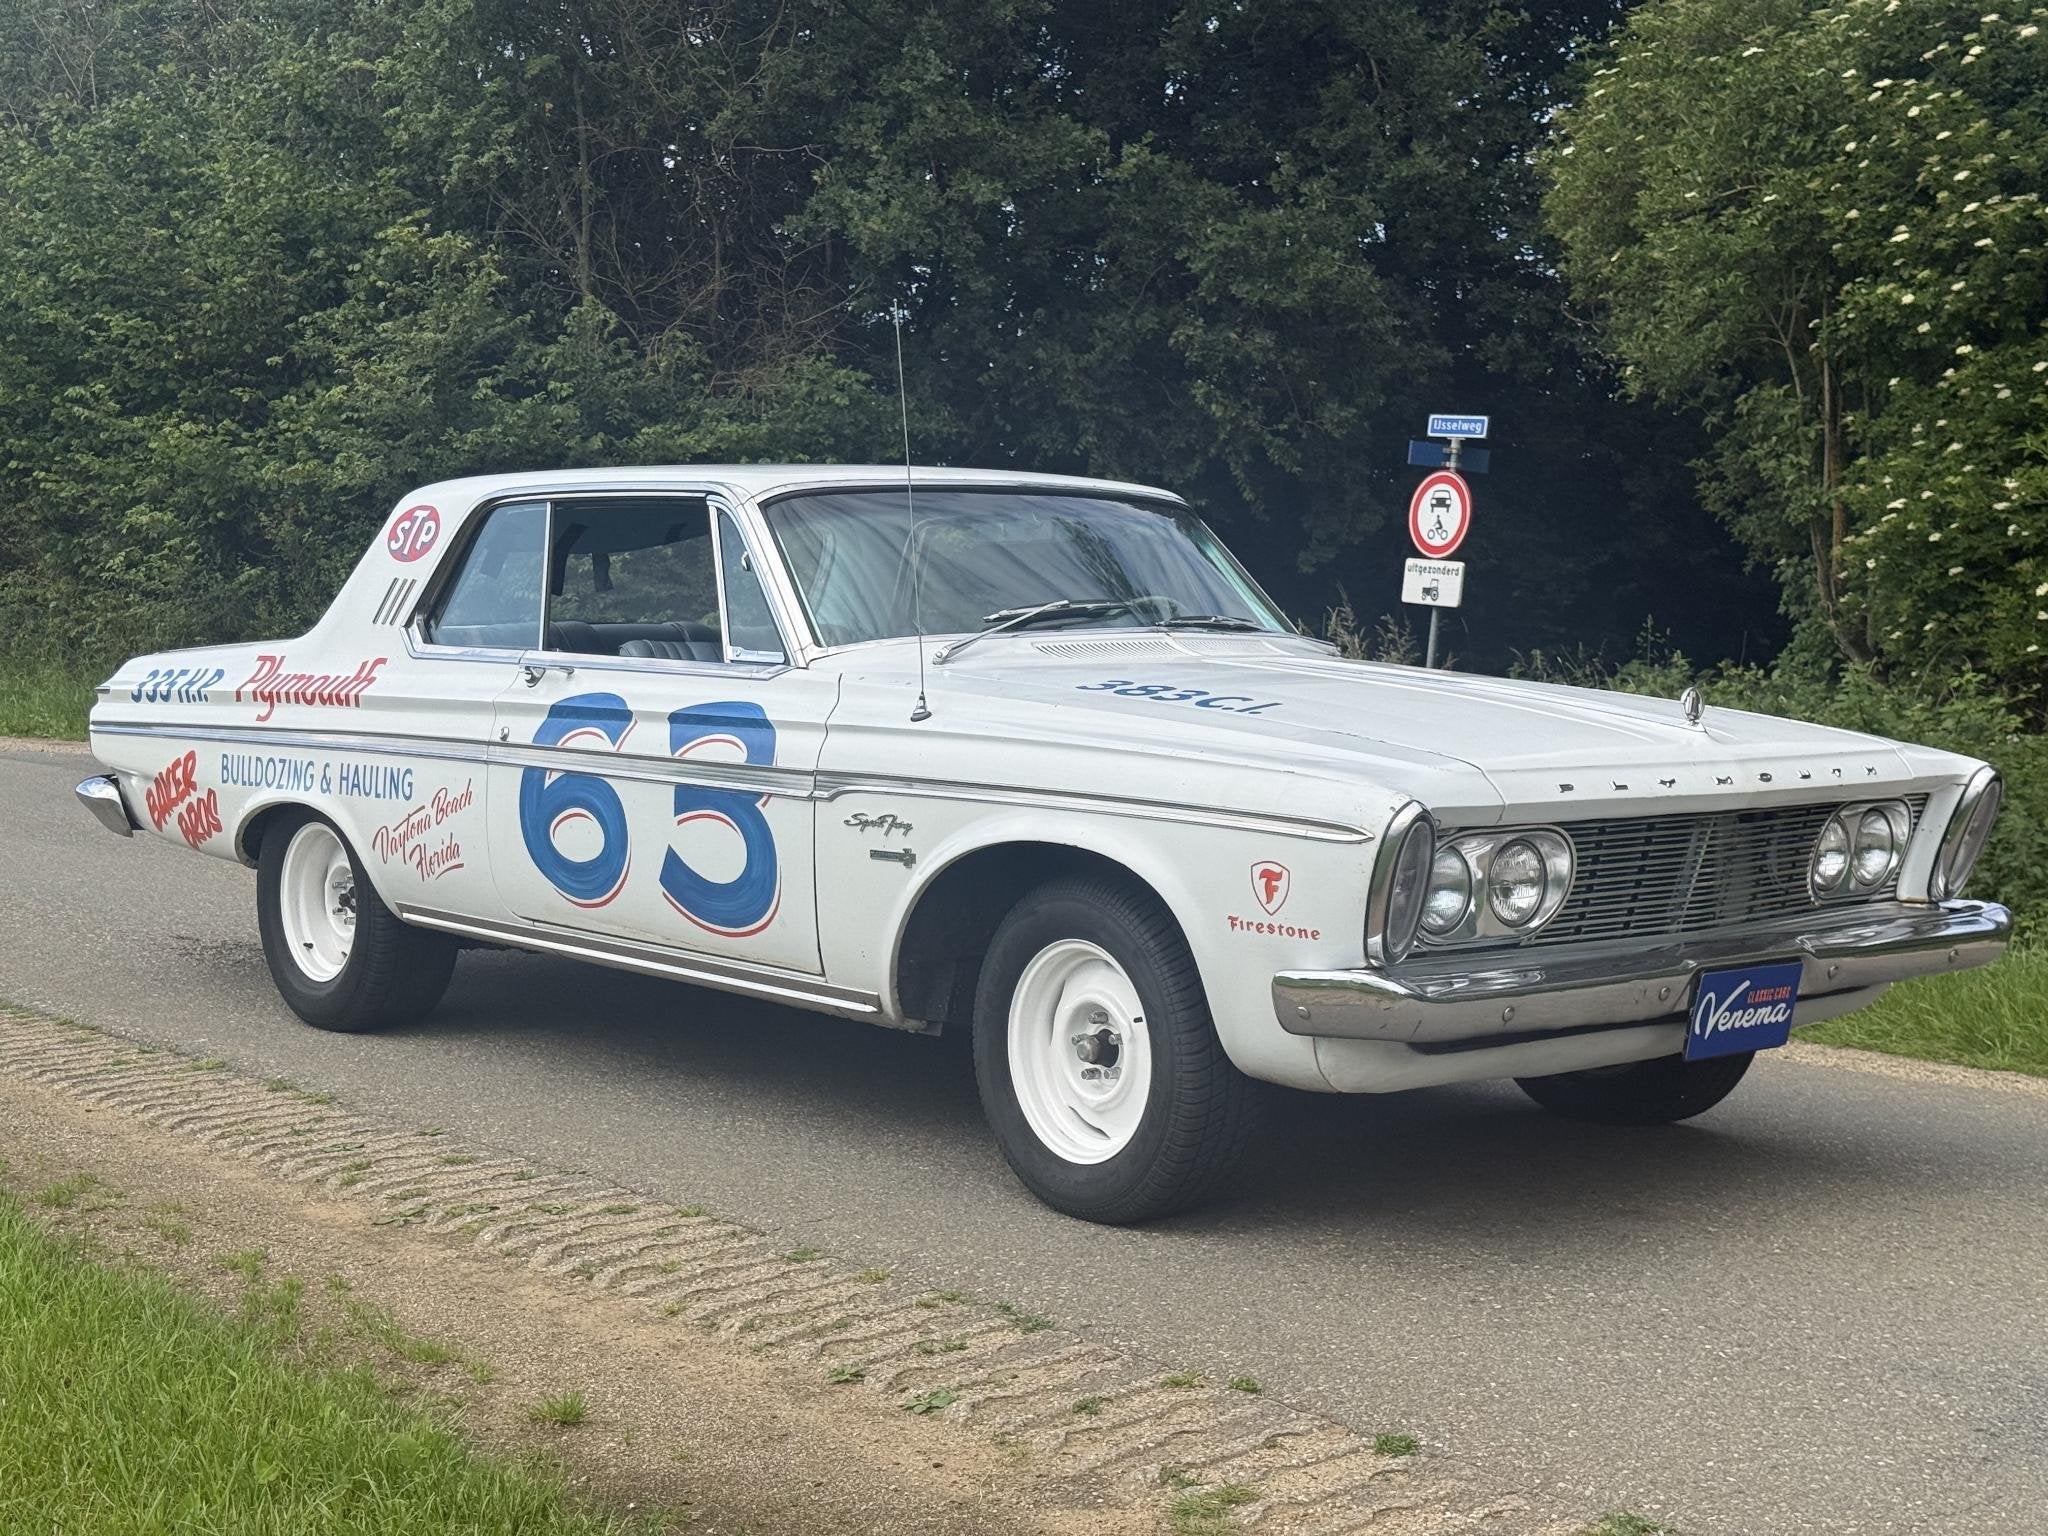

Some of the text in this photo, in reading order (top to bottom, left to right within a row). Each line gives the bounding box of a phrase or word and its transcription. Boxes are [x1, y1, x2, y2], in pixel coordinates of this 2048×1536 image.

[390, 509, 437, 556] STP
[1407, 562, 1460, 577] uitgezonderd
[235, 655, 388, 722] Plymouth
[145, 750, 198, 832] BAKER
[221, 753, 414, 801] BULLDOZING & HAULING
[1557, 765, 1878, 793] PLYMOUTH
[177, 787, 223, 849] BROS
[372, 778, 473, 865] Daytona Beach
[519, 692, 781, 937] 63
[409, 832, 464, 882] Florida
[1227, 915, 1321, 941] Firestone
[1694, 979, 1791, 1040] Venema
